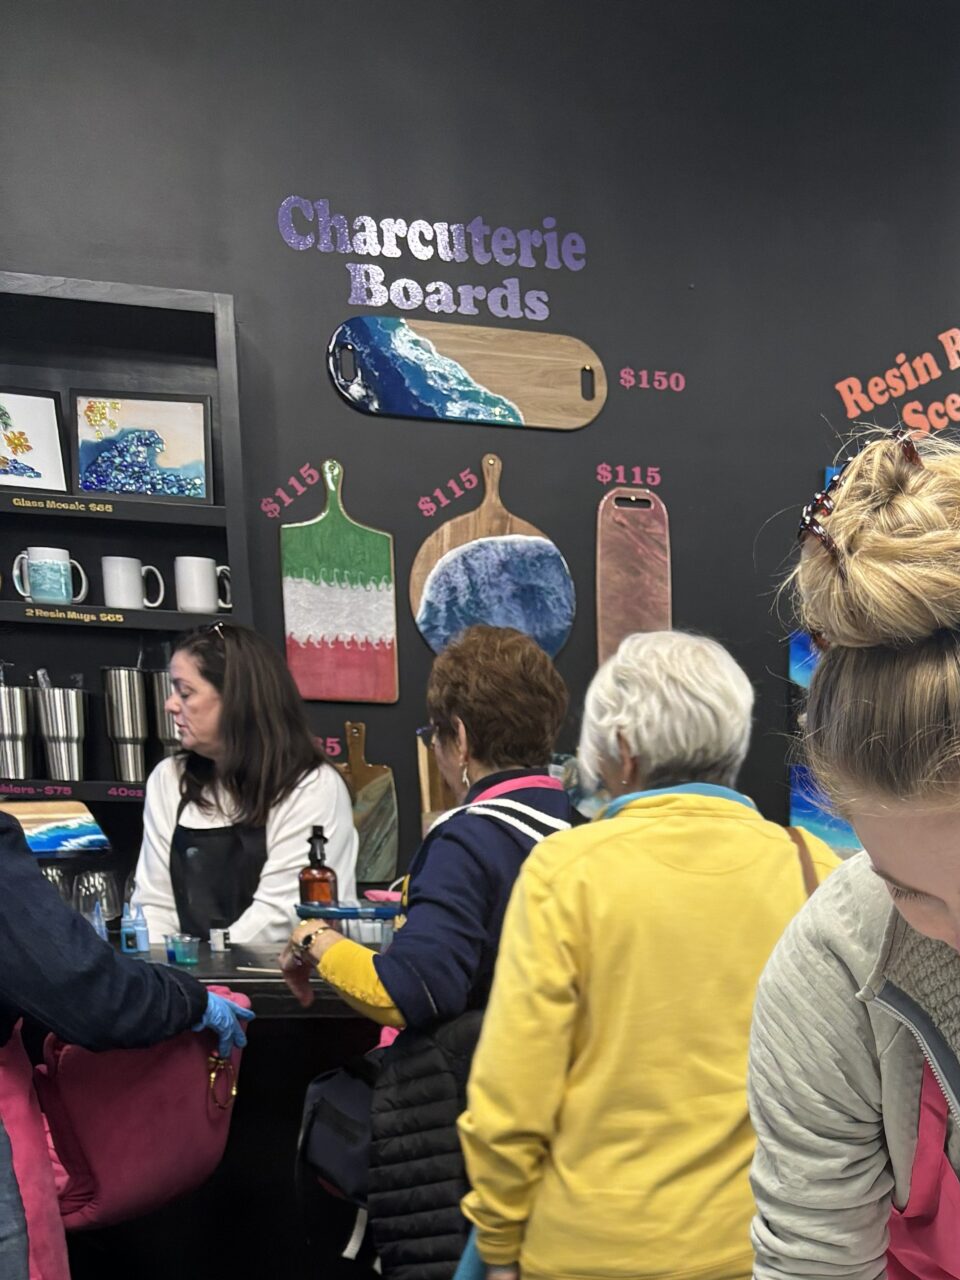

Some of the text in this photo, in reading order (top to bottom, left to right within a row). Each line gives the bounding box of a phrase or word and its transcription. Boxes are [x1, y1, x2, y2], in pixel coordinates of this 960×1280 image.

[278, 195, 587, 271] Charcuterie
[345, 262, 550, 321] Boards
[619, 367, 686, 392] $150
[834, 352, 943, 420] Resin
[260, 463, 320, 519] $115
[417, 468, 479, 518] $115
[596, 463, 661, 486] $115
[12, 497, 44, 508] Glass
[46, 500, 86, 511] Mosaic
[25, 608, 34, 617] 2
[35, 608, 66, 619] Resin
[67, 610, 97, 622] Mugs
[108, 787, 144, 797] 40oz
